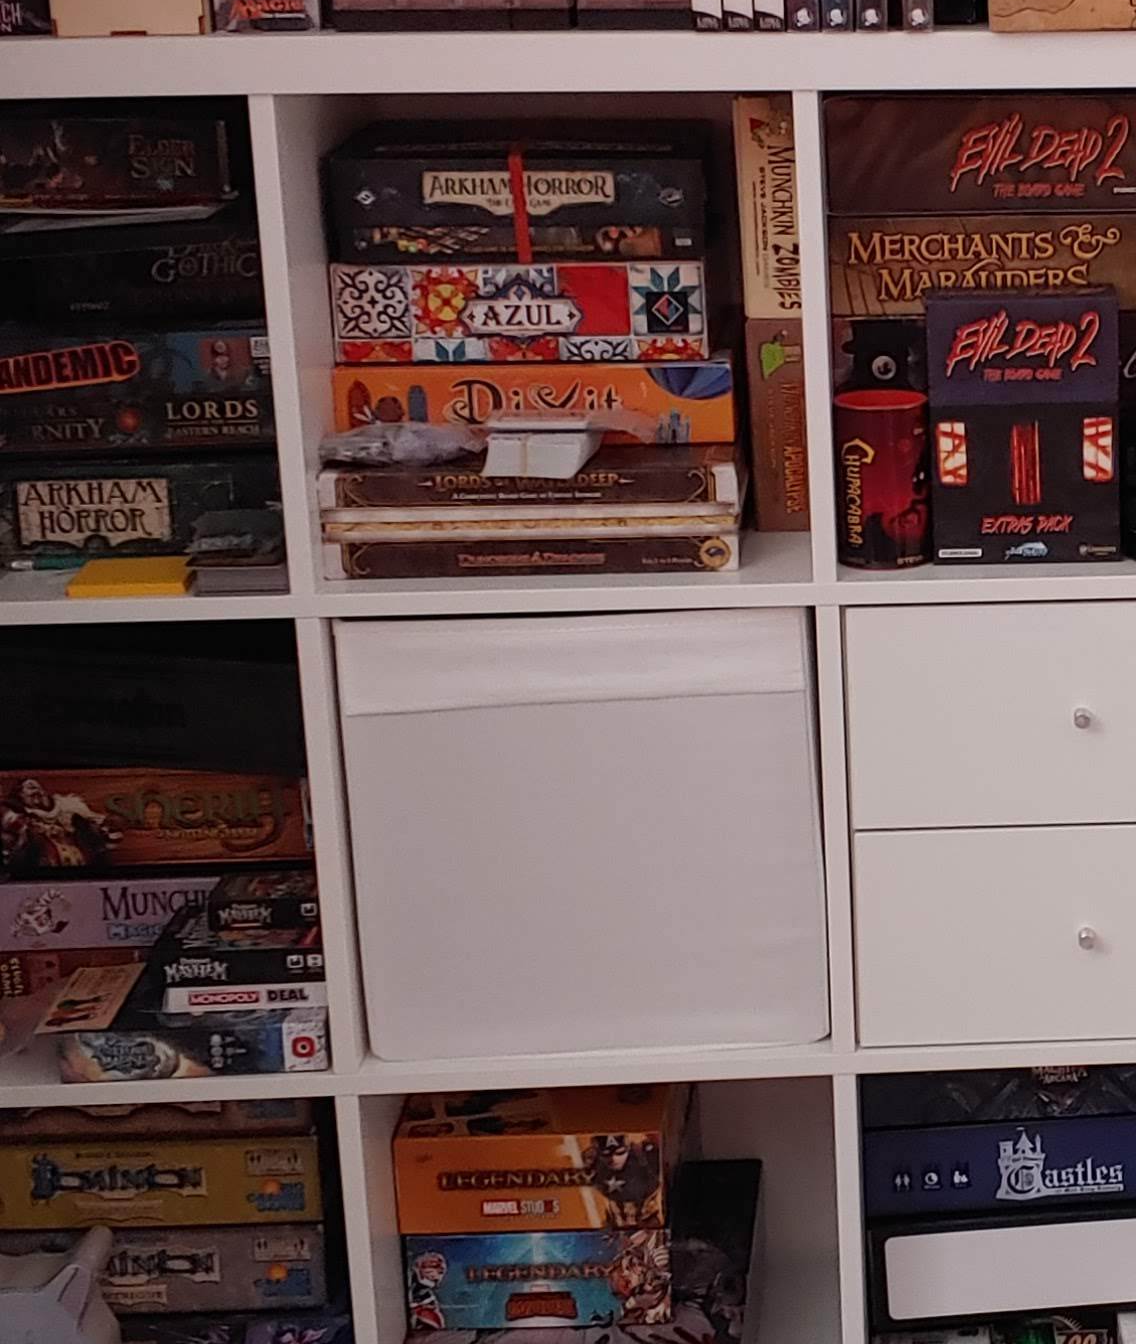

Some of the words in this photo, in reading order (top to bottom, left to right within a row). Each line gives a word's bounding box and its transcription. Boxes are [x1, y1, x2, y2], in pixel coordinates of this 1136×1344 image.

[951, 113, 1023, 193] EVIL
[1018, 124, 1103, 183] DEAD
[1096, 113, 1129, 188] 2
[767, 143, 799, 238] MUNCHKIN
[848, 228, 1053, 266] MERCHANTS
[1057, 222, 1123, 260] &
[151, 253, 258, 284] GOTHIC
[773, 241, 803, 312] ZOMBIES
[481, 304, 563, 327] AZUL
[945, 306, 1011, 379] EVIL
[1004, 318, 1078, 370] DEAD
[1070, 310, 1101, 373] 2
[0, 341, 139, 390] ANDEMIC
[165, 399, 259, 421] LORDS
[22, 480, 163, 510] ARKHAM
[841, 437, 876, 549] CHUPACABRA
[39, 509, 153, 540] HORROR
[979, 513, 1036, 536] EXTRAS
[1035, 512, 1076, 536] PACK
[266, 988, 309, 1003] DEAL
[440, 1169, 599, 1191] LEGENDARY
[465, 1261, 612, 1283] LEGENDARY
